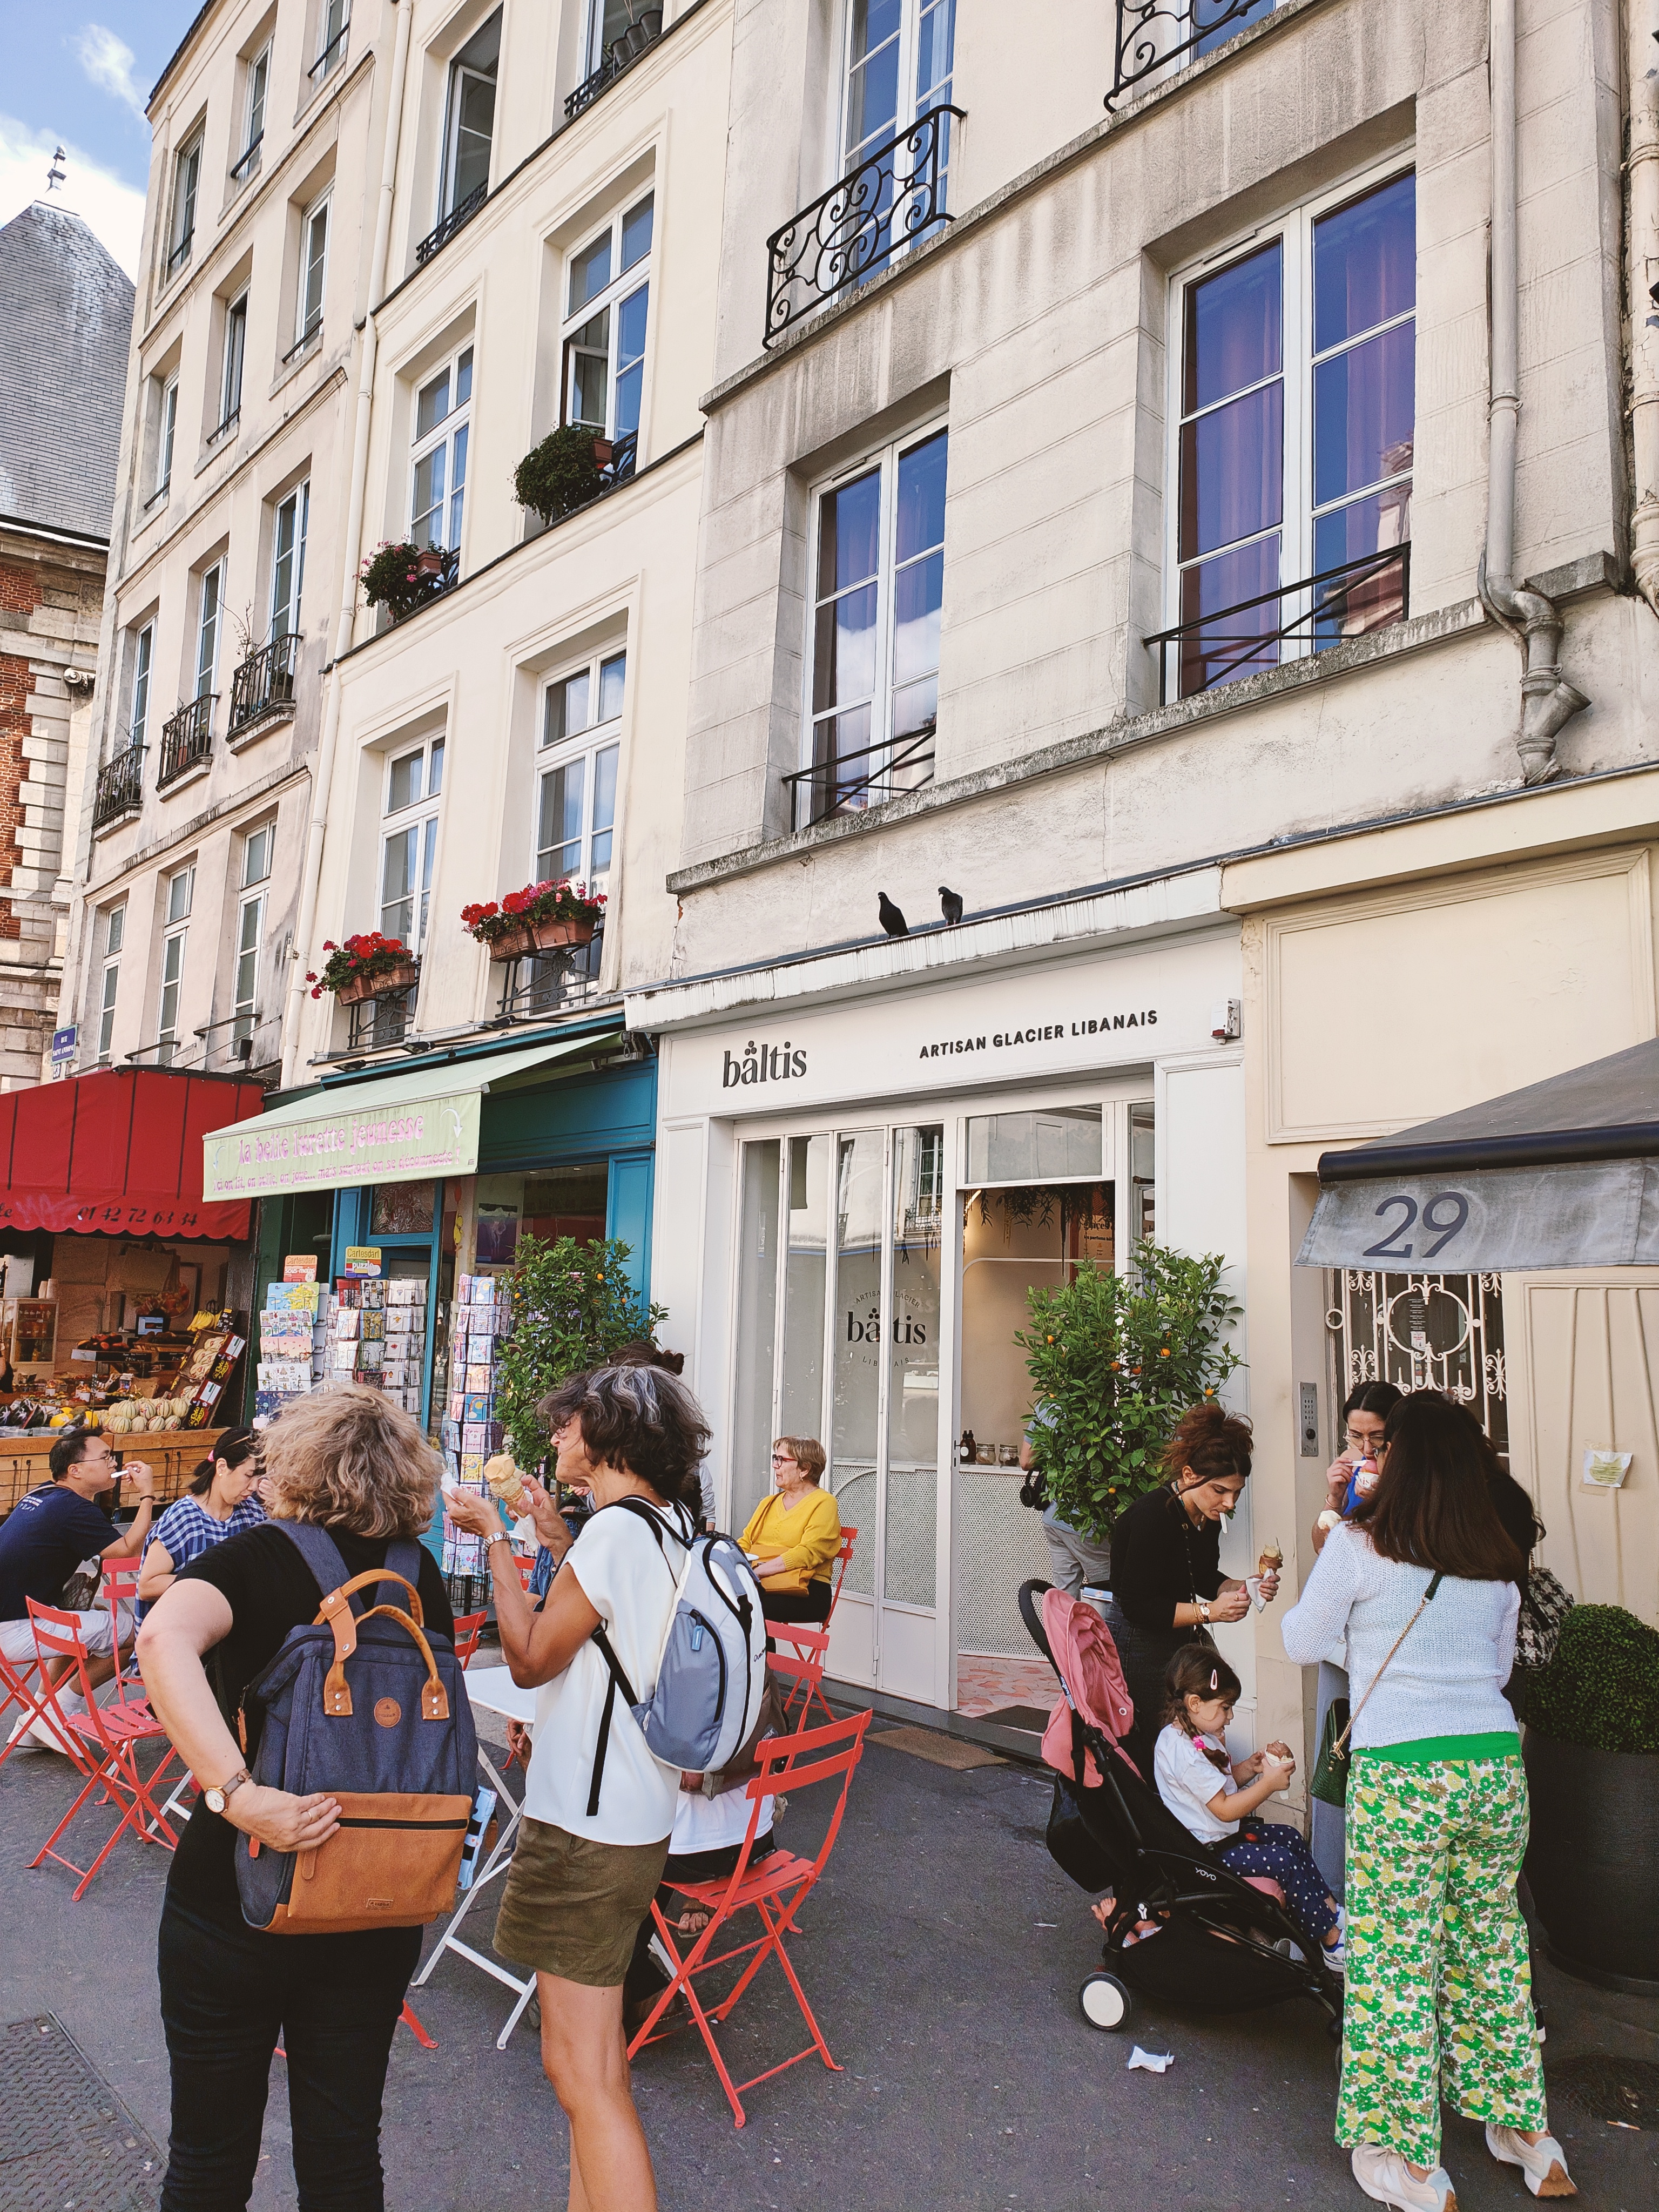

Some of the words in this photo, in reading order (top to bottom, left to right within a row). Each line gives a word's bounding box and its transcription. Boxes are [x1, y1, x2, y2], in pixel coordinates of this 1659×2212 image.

[919, 1036, 986, 1059] ARTISAN
[993, 1025, 1063, 1048] GLACIER
[1071, 1010, 1157, 1036] LIBANAIS
[239, 1139, 251, 1164] la
[256, 1132, 289, 1163] belle
[293, 1125, 346, 1158] lurette
[350, 1115, 424, 1155] jeunesse
[225, 1180, 233, 1191] on
[247, 1177, 256, 1188] on
[280, 1174, 289, 1184] on
[318, 1164, 336, 1179] mais
[373, 1161, 383, 1174] on
[387, 1159, 396, 1172] se
[129, 1208, 147, 1223] 72
[1361, 1191, 1469, 1259] 29
[855, 1290, 881, 1304] ARTISA
[894, 1291, 920, 1309] LACIER
[862, 1356, 909, 1367] LIBAIS
